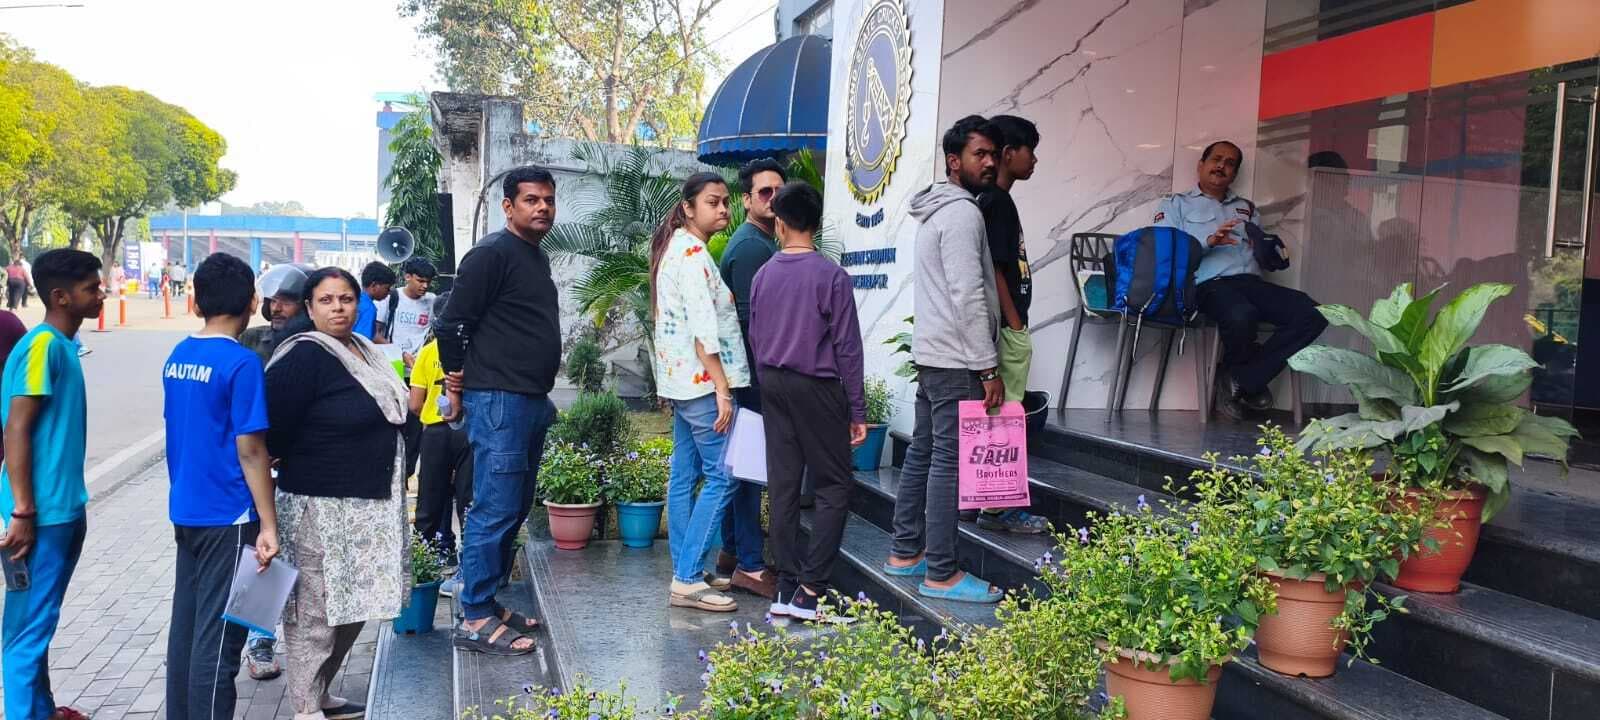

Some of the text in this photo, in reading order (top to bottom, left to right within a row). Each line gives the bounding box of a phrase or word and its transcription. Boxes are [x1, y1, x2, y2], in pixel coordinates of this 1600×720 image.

[856, 17, 876, 63] STATE
[877, 8, 901, 40] CRICKET
[969, 445, 1019, 466] SAHU
